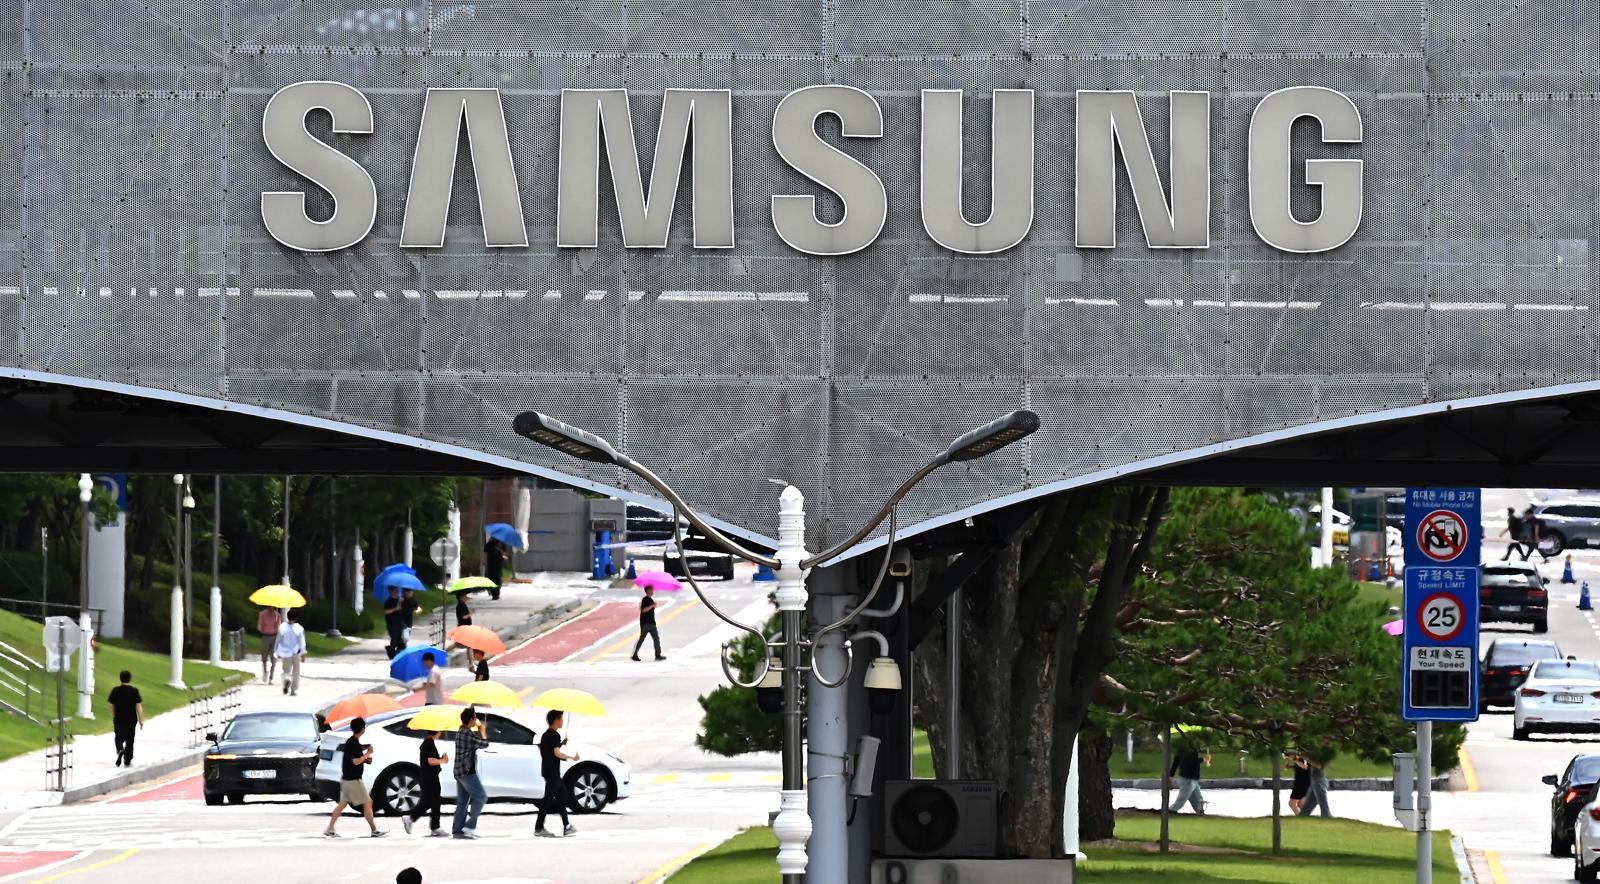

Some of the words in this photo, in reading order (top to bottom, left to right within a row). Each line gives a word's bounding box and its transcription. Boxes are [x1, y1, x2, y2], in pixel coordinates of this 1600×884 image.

[261, 81, 1364, 256] SAMSUNG
[1412, 490, 1436, 501] 휴대폰
[1439, 490, 1456, 501] 사용
[1459, 491, 1475, 501] 금지
[1418, 569, 1466, 581] 규정속도
[1428, 606, 1456, 628] 25
[1417, 649, 1465, 660] 현재속도
[1438, 661, 1465, 669] Speed
